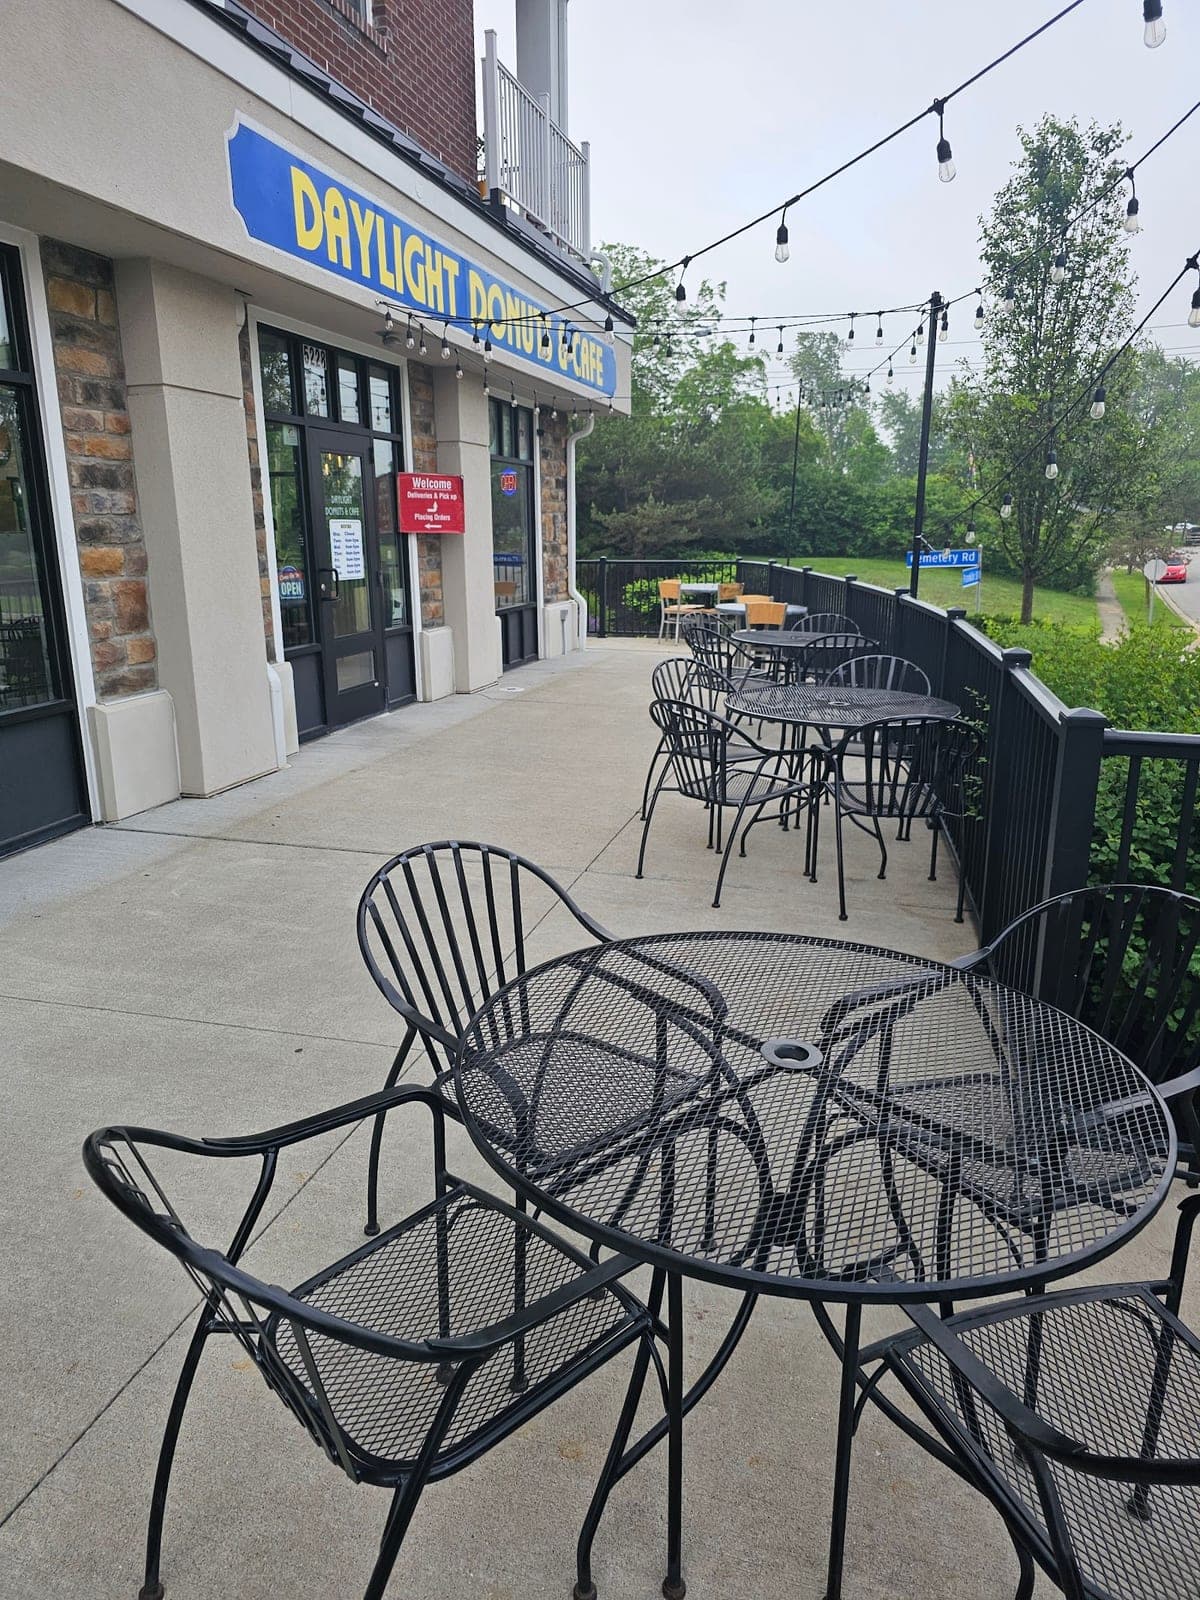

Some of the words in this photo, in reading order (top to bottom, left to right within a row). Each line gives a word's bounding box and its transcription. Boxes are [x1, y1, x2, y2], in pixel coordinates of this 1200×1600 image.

[290, 165, 460, 317] DAYLIGHT
[571, 331, 604, 387] CAFE
[412, 477, 452, 489] Welcome
[407, 491, 433, 499] Deliveries
[414, 513, 433, 522] Placing
[962, 552, 975, 562] Rd
[281, 581, 302, 596] OPEN
